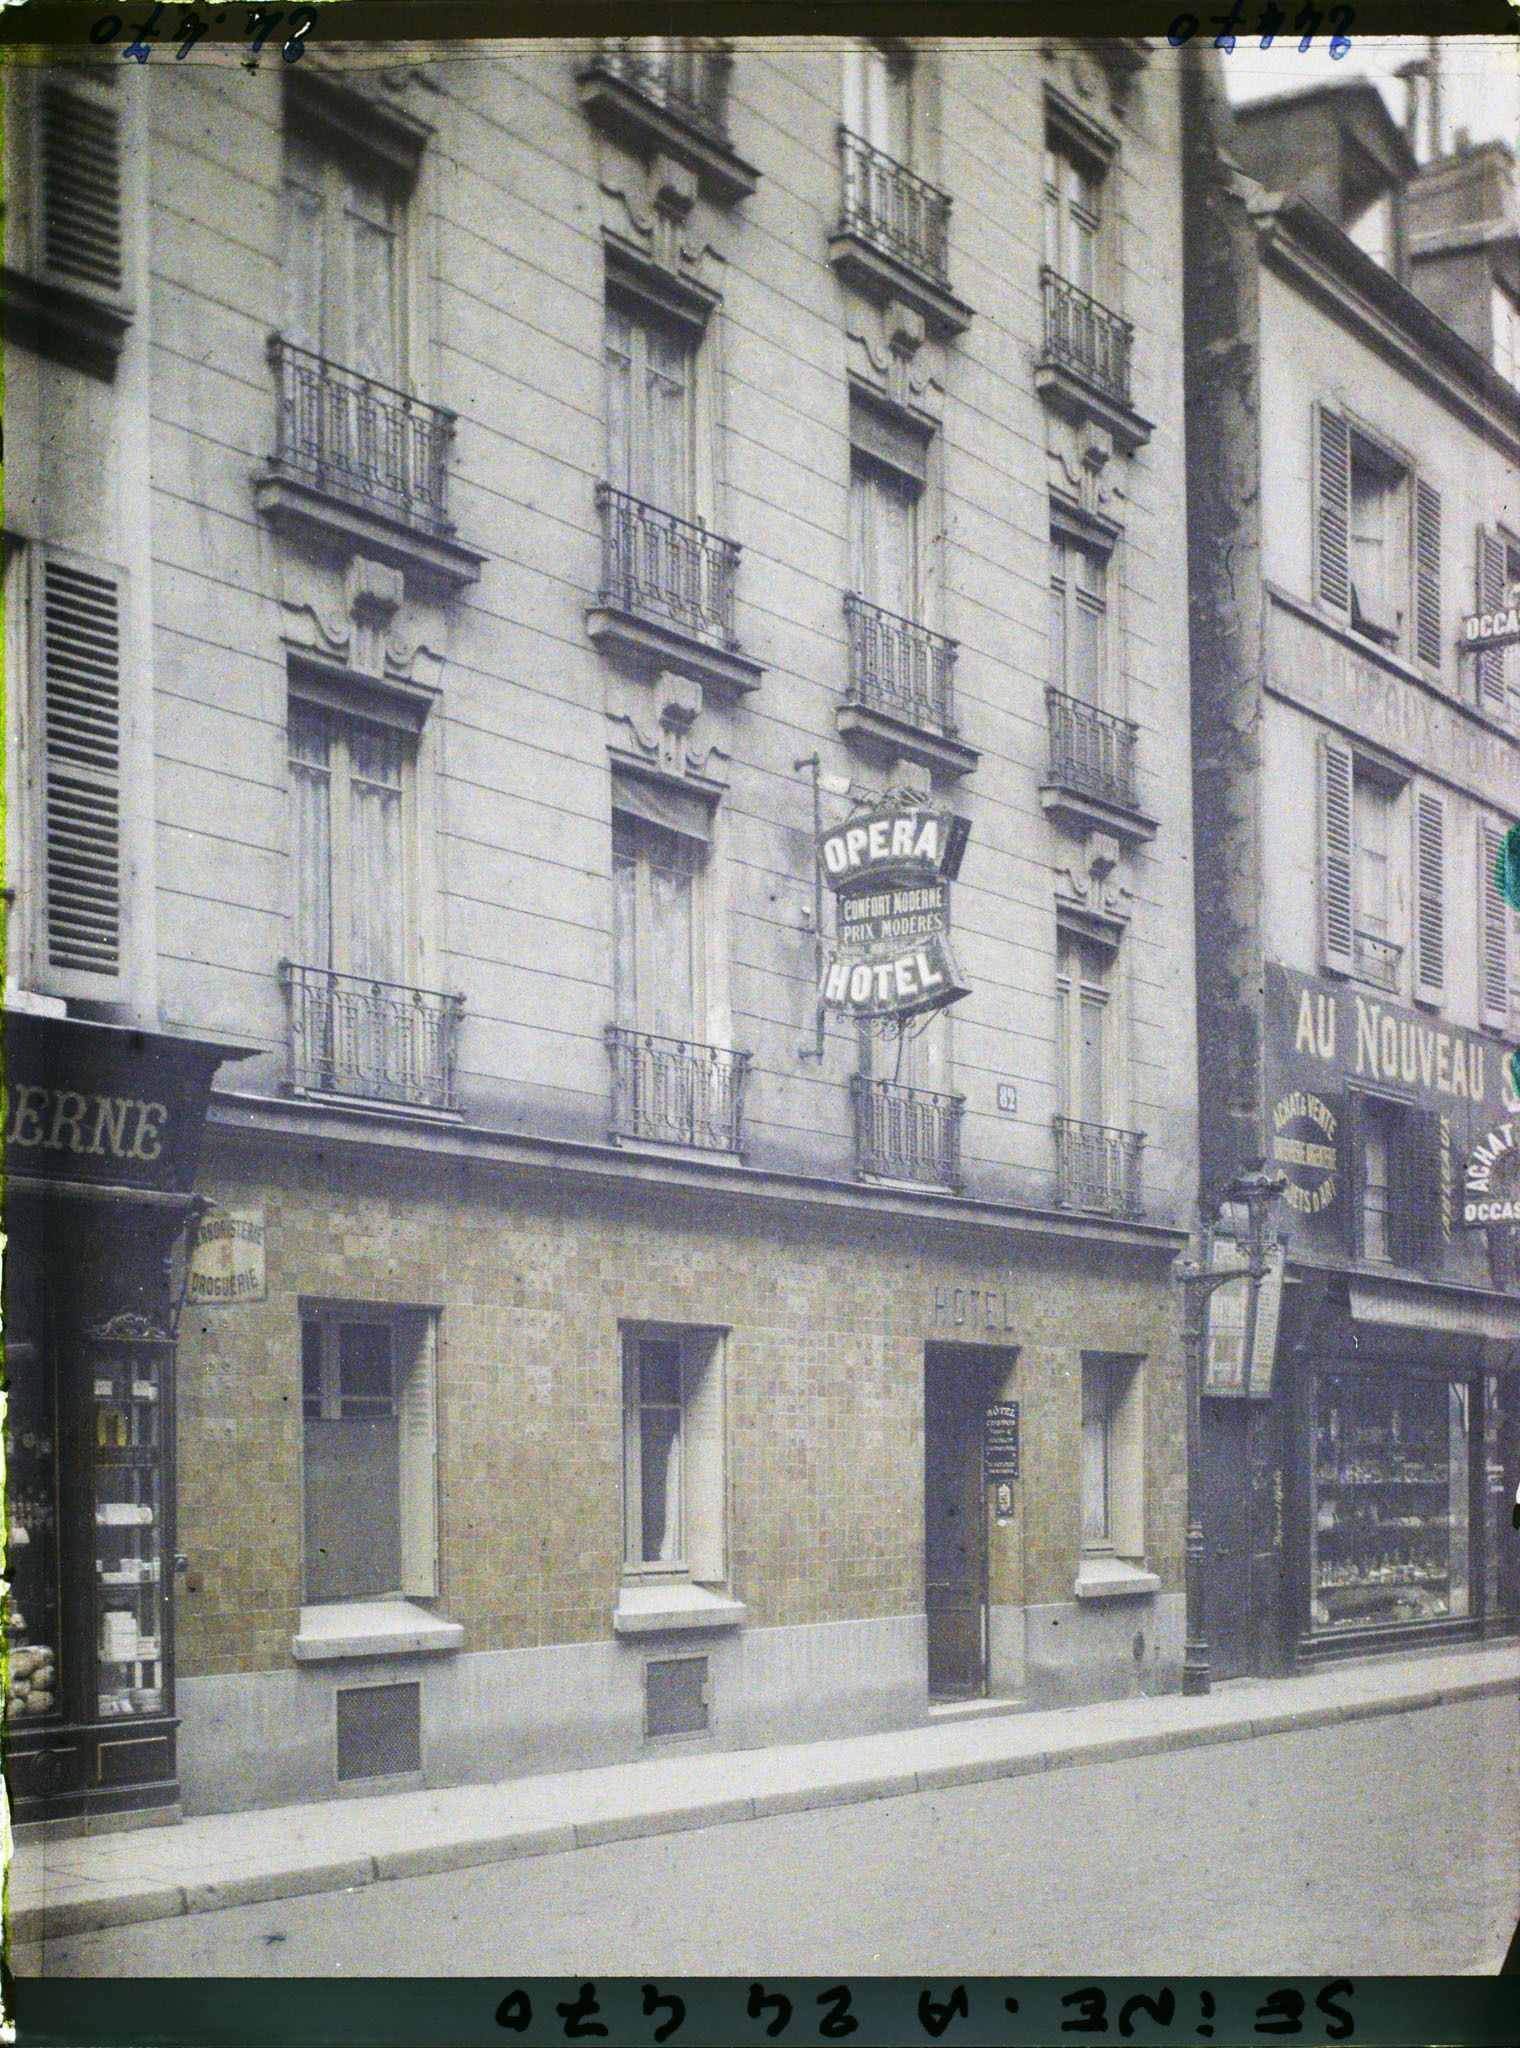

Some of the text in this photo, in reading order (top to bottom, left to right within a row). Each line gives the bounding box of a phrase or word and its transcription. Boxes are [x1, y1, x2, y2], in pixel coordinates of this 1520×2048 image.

[1466, 609, 1520, 640] OCCA
[823, 819, 939, 874] OPERA
[843, 887, 944, 921] CONFORT MODERNE
[842, 921, 874, 943] PRIX
[825, 951, 944, 1001] HOTEL
[1295, 989, 1336, 1059] AU
[1355, 995, 1485, 1101] NOUVEAU
[3, 1083, 168, 1160] ERNE
